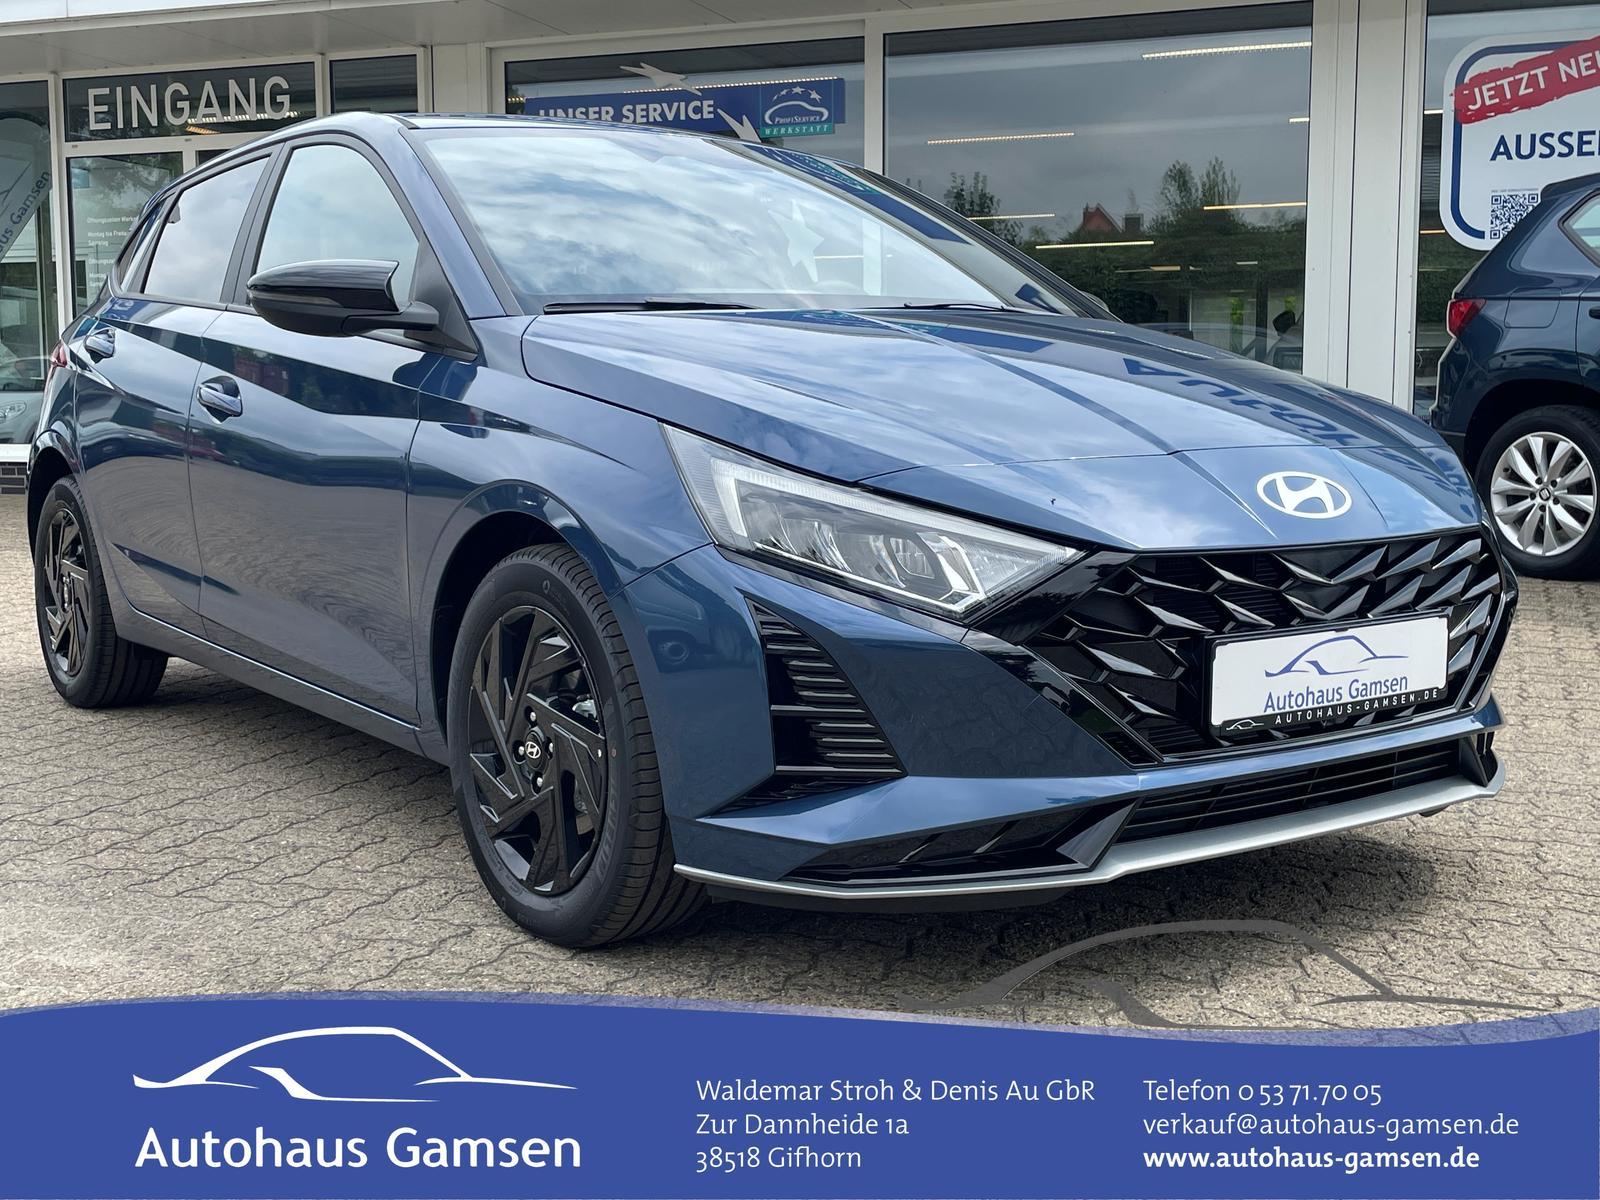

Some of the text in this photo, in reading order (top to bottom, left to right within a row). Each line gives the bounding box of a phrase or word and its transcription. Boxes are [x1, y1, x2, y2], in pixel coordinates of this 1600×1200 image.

[88, 76, 291, 131] EINGANG
[1468, 66, 1548, 110] JETZT
[622, 100, 714, 124] SERVICE
[765, 125, 828, 135] WERKSTATT
[1489, 130, 1600, 161] AUSSE
[10, 171, 51, 225] Gamsen
[1264, 675, 1408, 713] Autohaus Gamsen
[1275, 688, 1438, 725] AUTOHAUS-GAMSEN.DE
